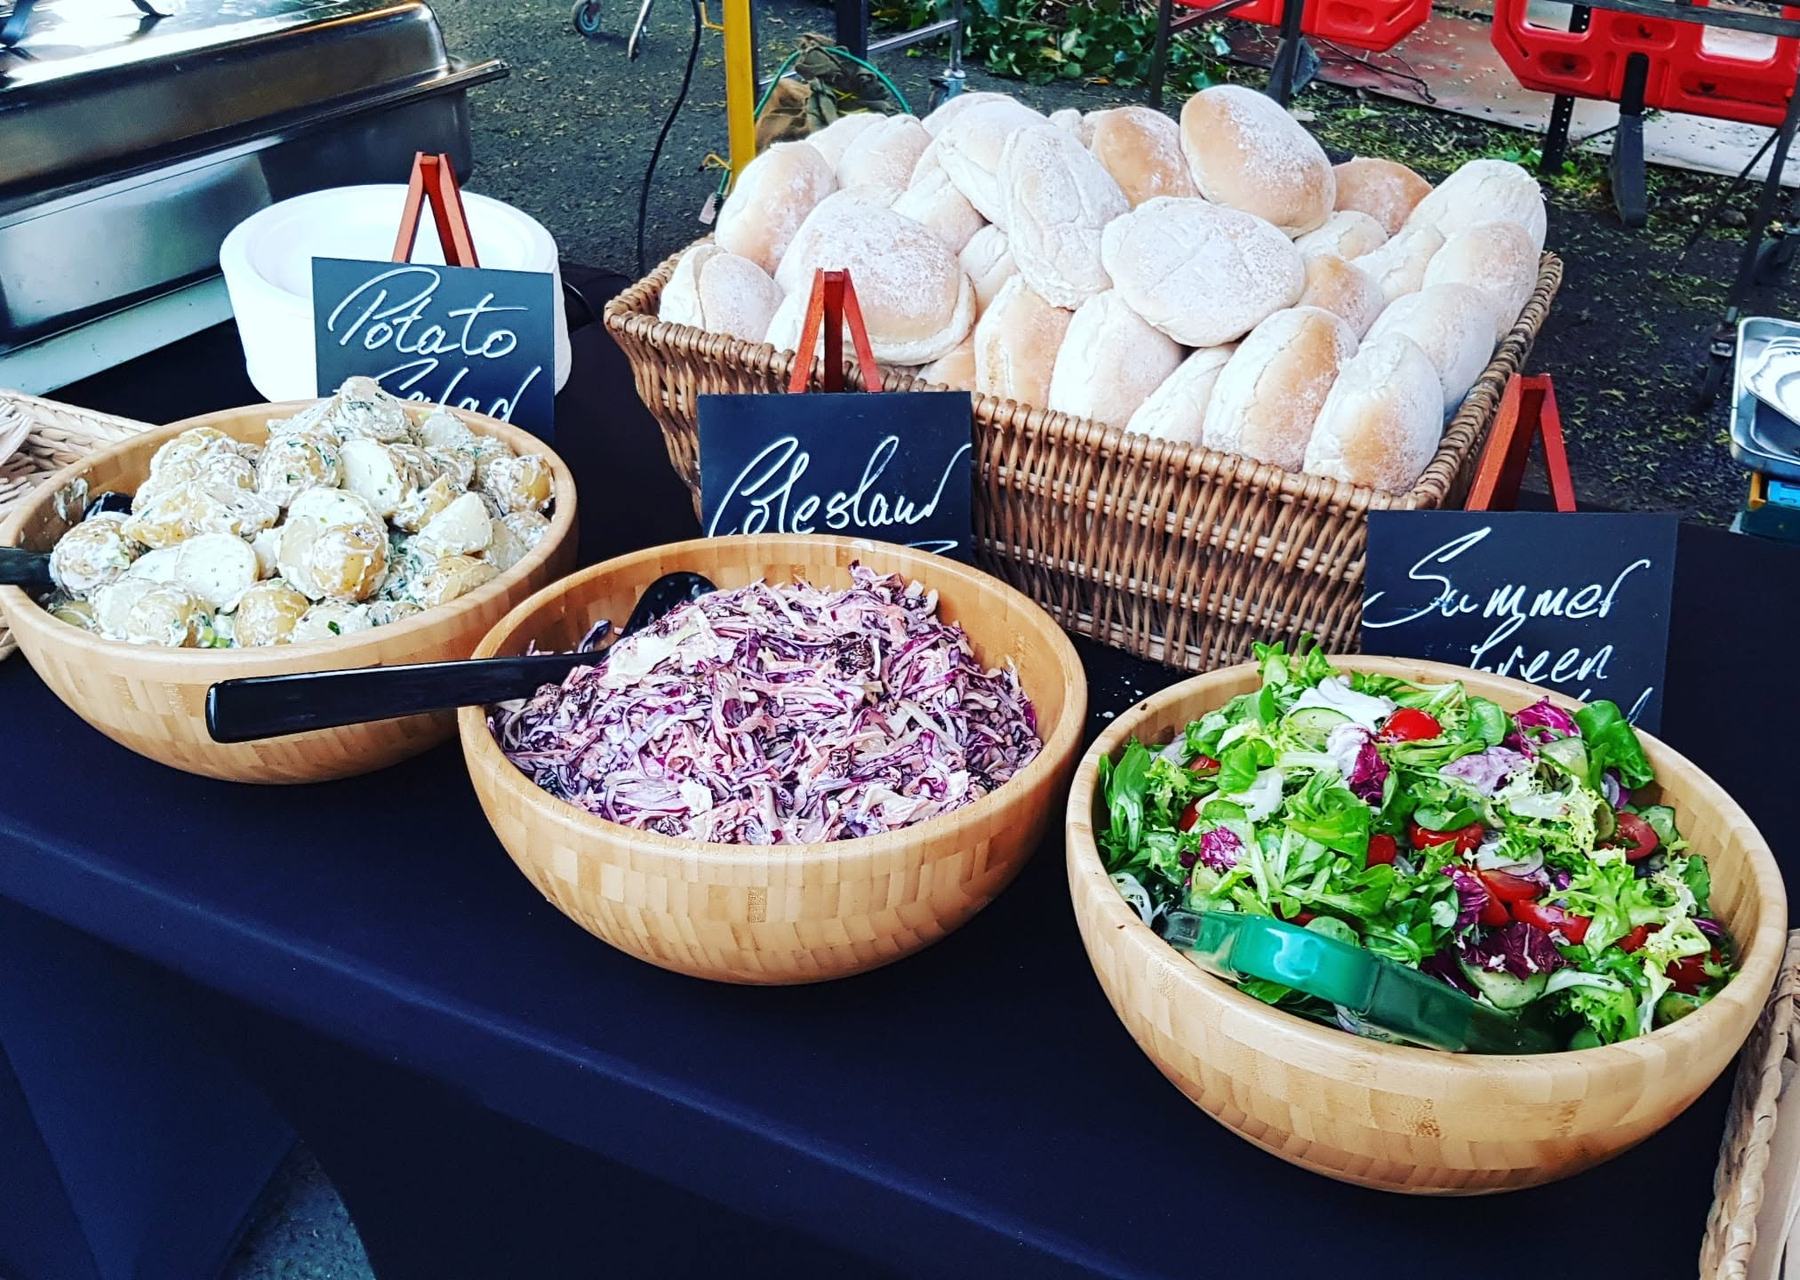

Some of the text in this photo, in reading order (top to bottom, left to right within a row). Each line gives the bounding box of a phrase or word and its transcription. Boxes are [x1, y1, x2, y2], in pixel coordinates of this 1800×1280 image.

[328, 266, 528, 358] Potato
[707, 435, 972, 538] Coleslaw
[1361, 526, 1650, 628] Summer
